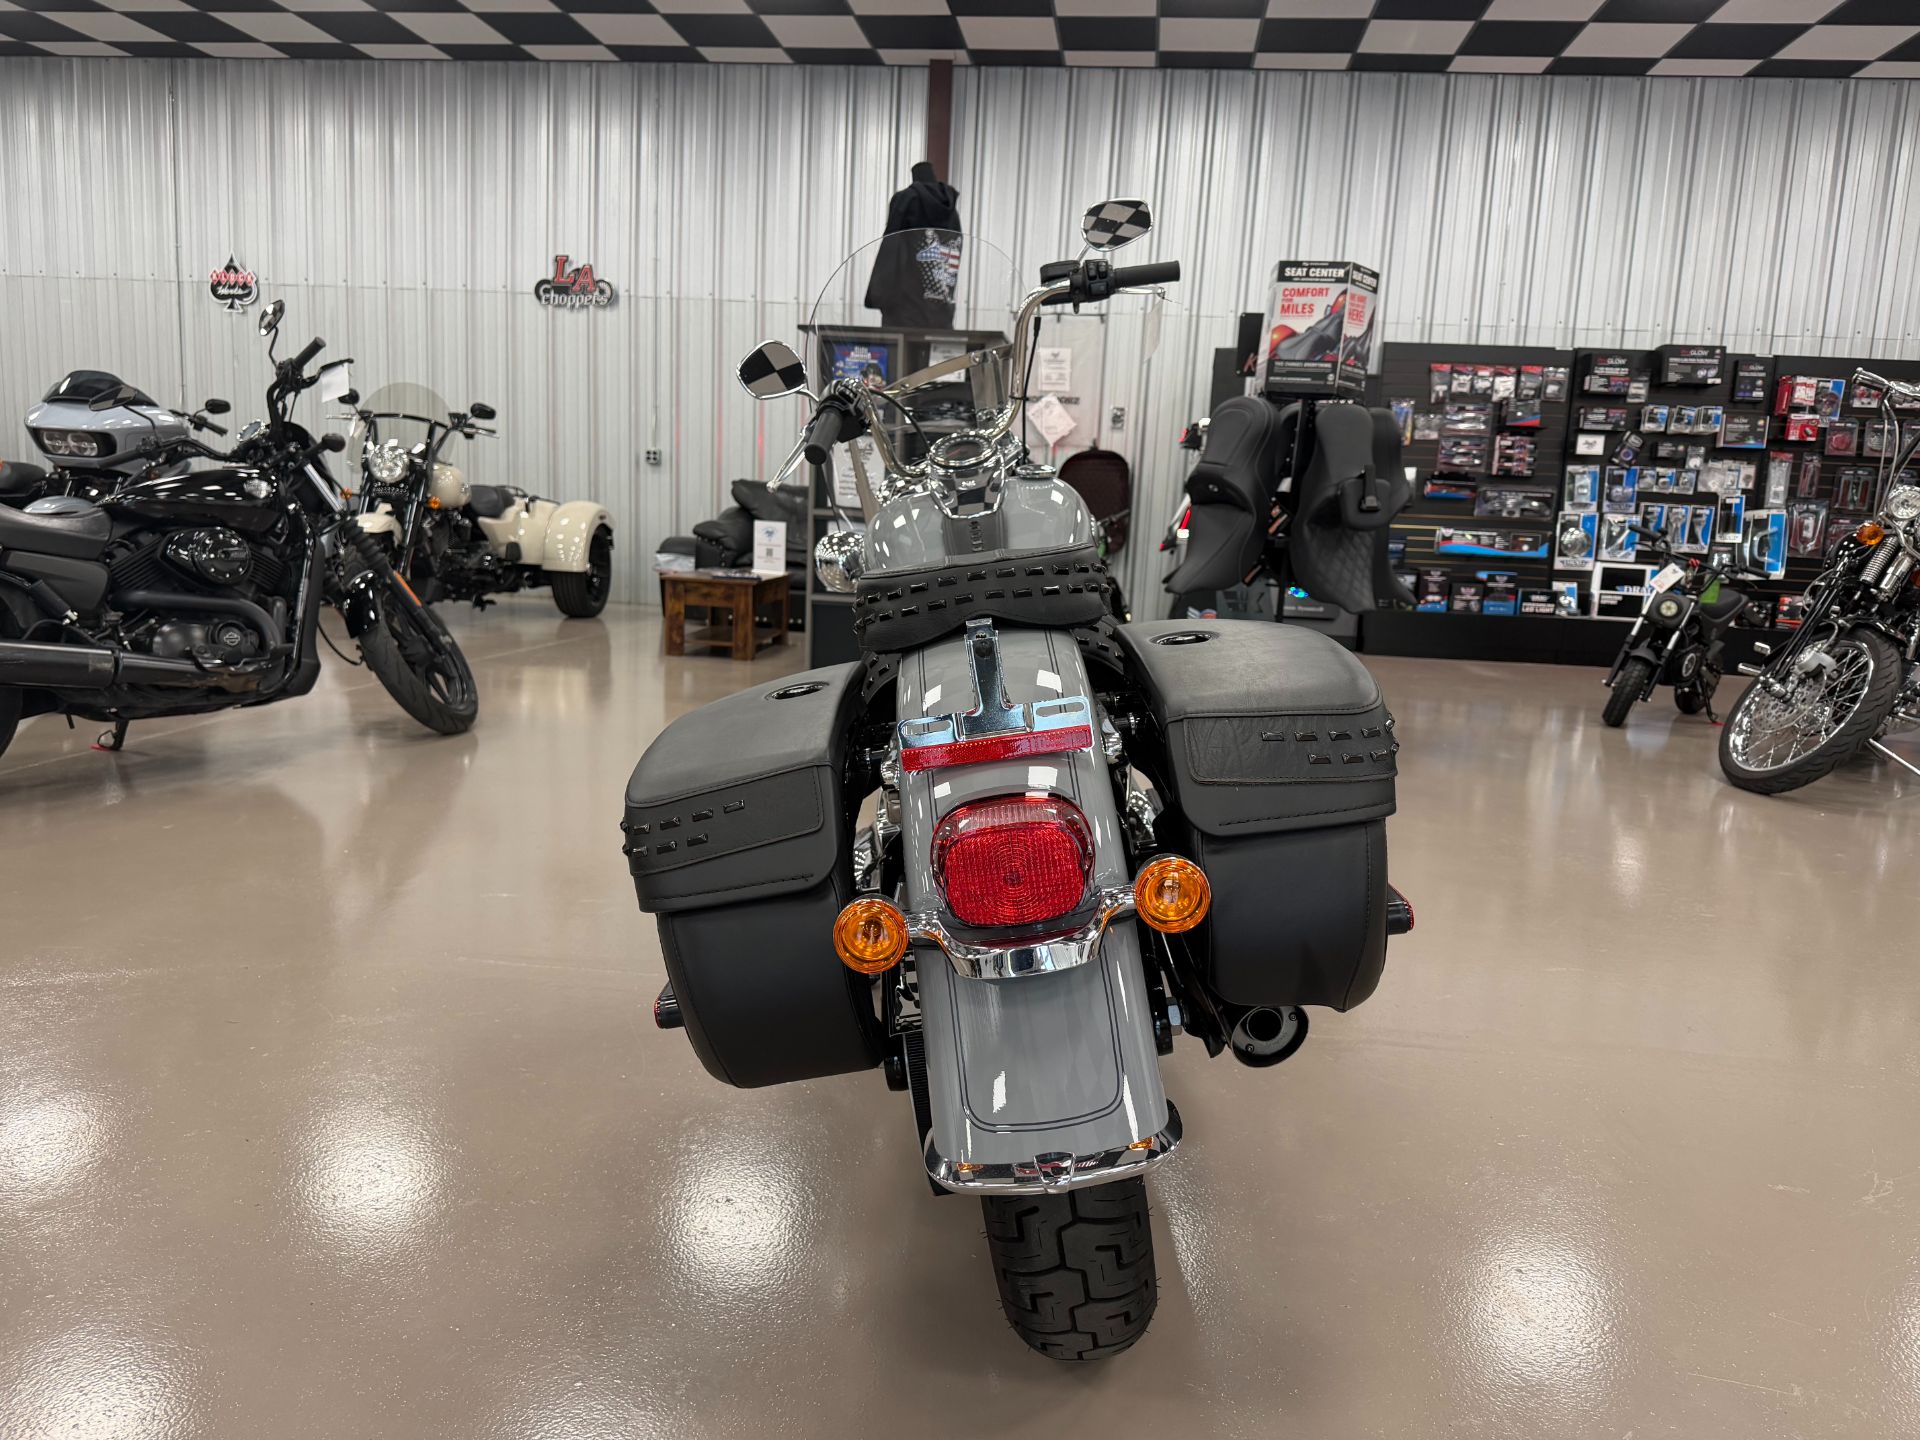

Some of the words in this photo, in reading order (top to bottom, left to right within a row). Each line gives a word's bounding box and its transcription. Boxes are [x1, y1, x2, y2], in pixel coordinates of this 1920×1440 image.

[553, 255, 597, 293] LA
[1284, 267, 1307, 277] SEAT
[1308, 268, 1345, 278] CENTER
[1282, 287, 1330, 298] COMFORT
[1280, 303, 1315, 315] MILES
